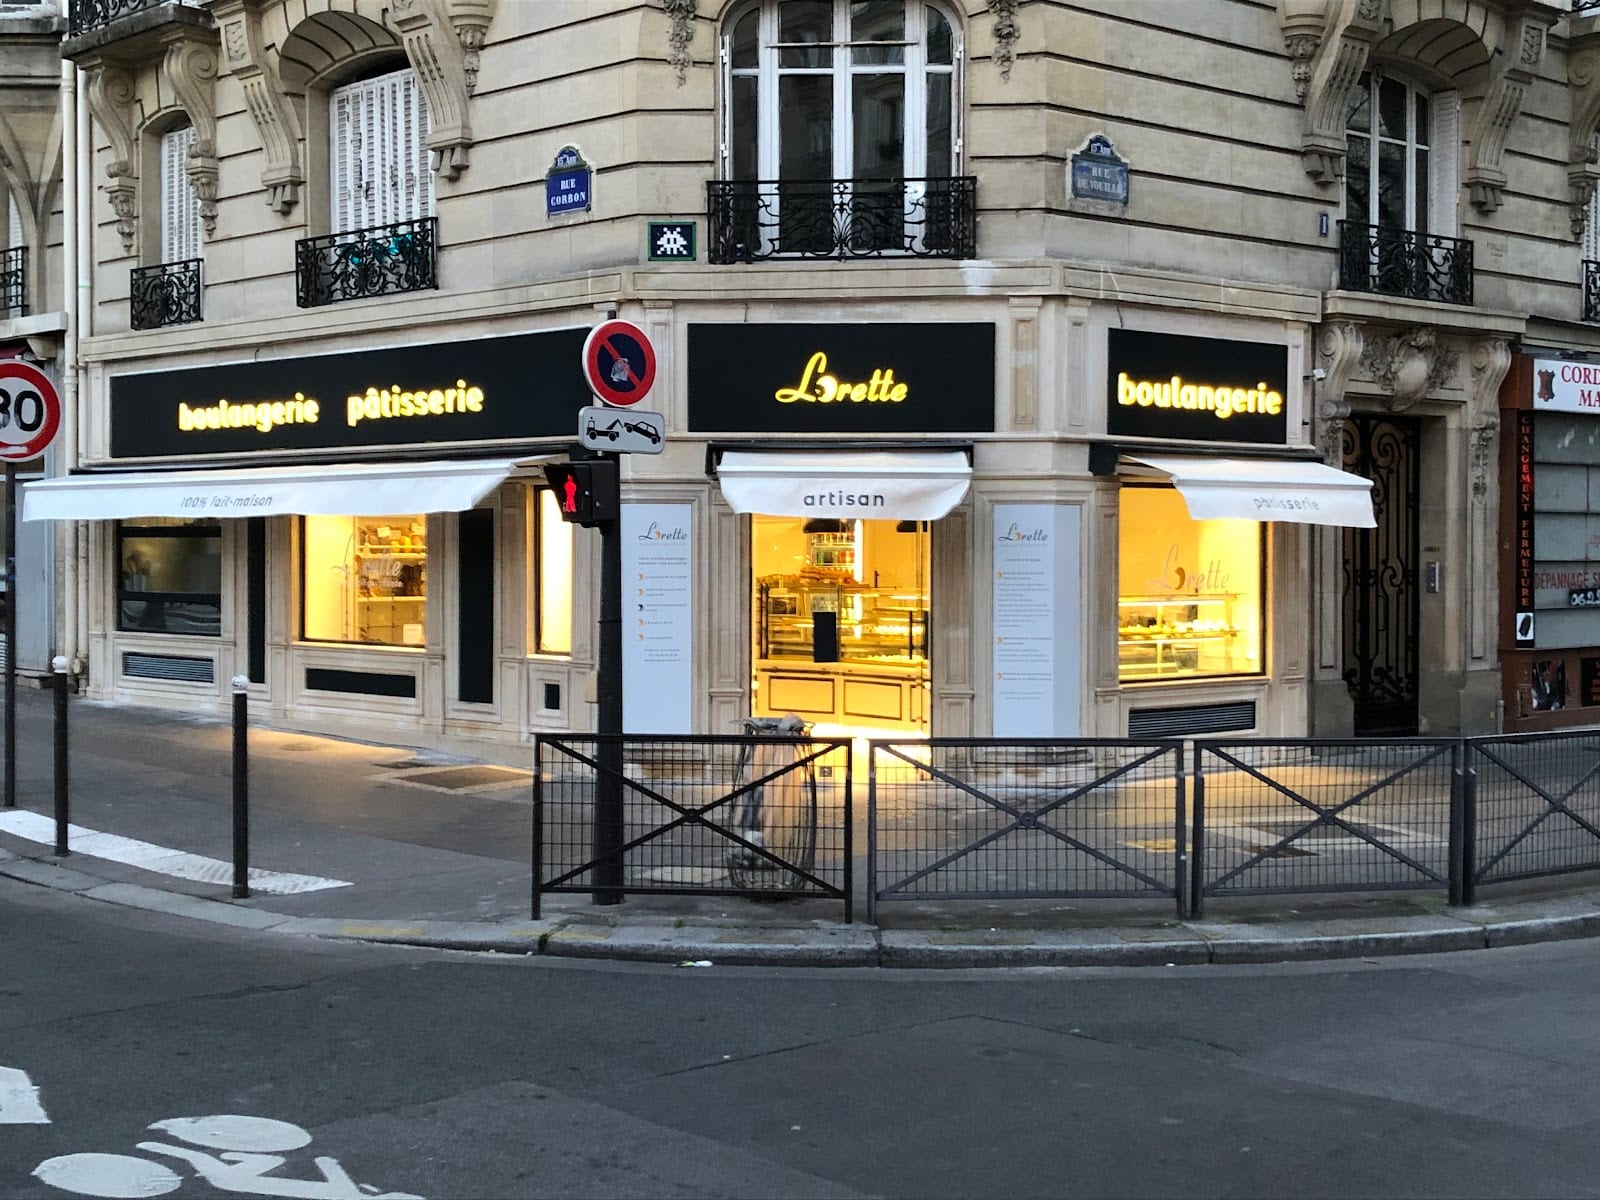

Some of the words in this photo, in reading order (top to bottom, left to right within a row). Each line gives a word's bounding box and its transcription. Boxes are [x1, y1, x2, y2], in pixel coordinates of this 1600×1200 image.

[1091, 166, 1111, 179] RUE
[560, 178, 576, 190] RUE
[1077, 178, 1089, 189] DE
[551, 192, 586, 206] CORBON
[775, 351, 908, 403] Lorette
[1117, 371, 1282, 419] boulangerie
[178, 391, 320, 433] boulangerie
[347, 378, 485, 428] pâtisserie
[1520, 415, 1531, 513] CHANGEMENT
[180, 496, 209, 509] 100%
[210, 493, 273, 508] fait-maison
[803, 489, 885, 507] artisan
[638, 521, 688, 541] Lorette
[998, 522, 1048, 542] Lorette
[1144, 543, 1230, 592] Lorette
[1520, 519, 1531, 607] FERMETURE
